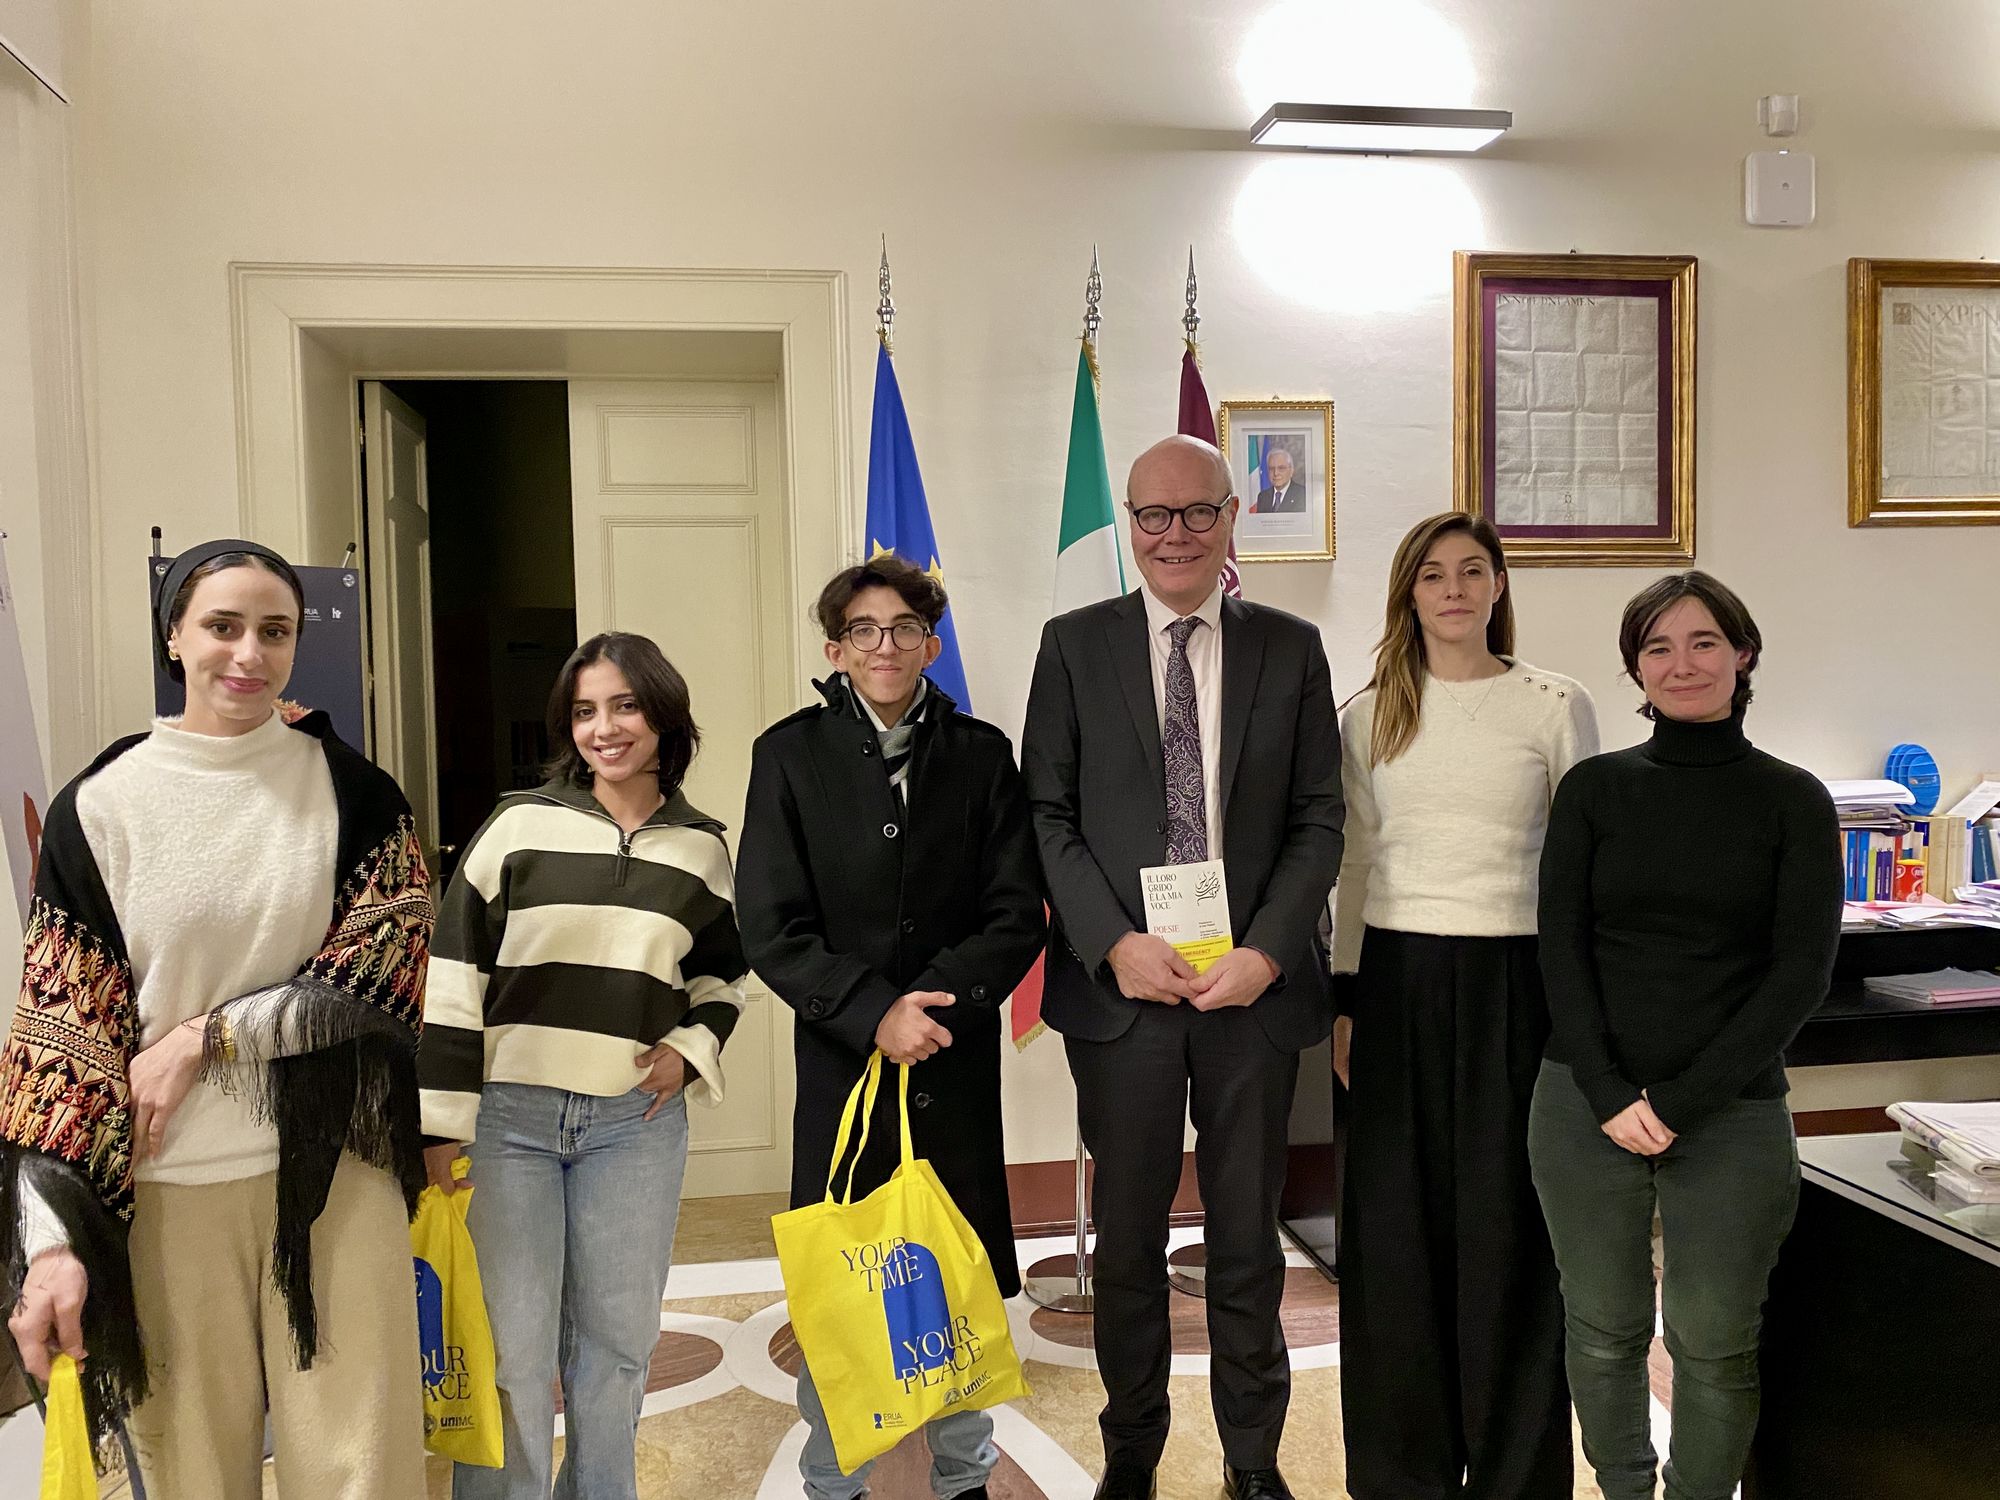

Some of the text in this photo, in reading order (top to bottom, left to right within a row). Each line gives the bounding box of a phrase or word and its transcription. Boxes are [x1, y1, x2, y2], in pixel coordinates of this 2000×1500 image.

[1147, 874, 1177, 883] IL LORO
[1148, 883, 1172, 892] GRIDO
[1156, 893, 1167, 901] LA
[1168, 892, 1183, 900] MIA
[1151, 902, 1171, 910] VOCE
[1154, 925, 1180, 933] POESIE
[840, 1236, 910, 1272] YOUR
[860, 1256, 924, 1293] TIME
[902, 1315, 975, 1364] YOUR
[901, 1337, 985, 1395] PLACE
[883, 1412, 903, 1421] ERUA
